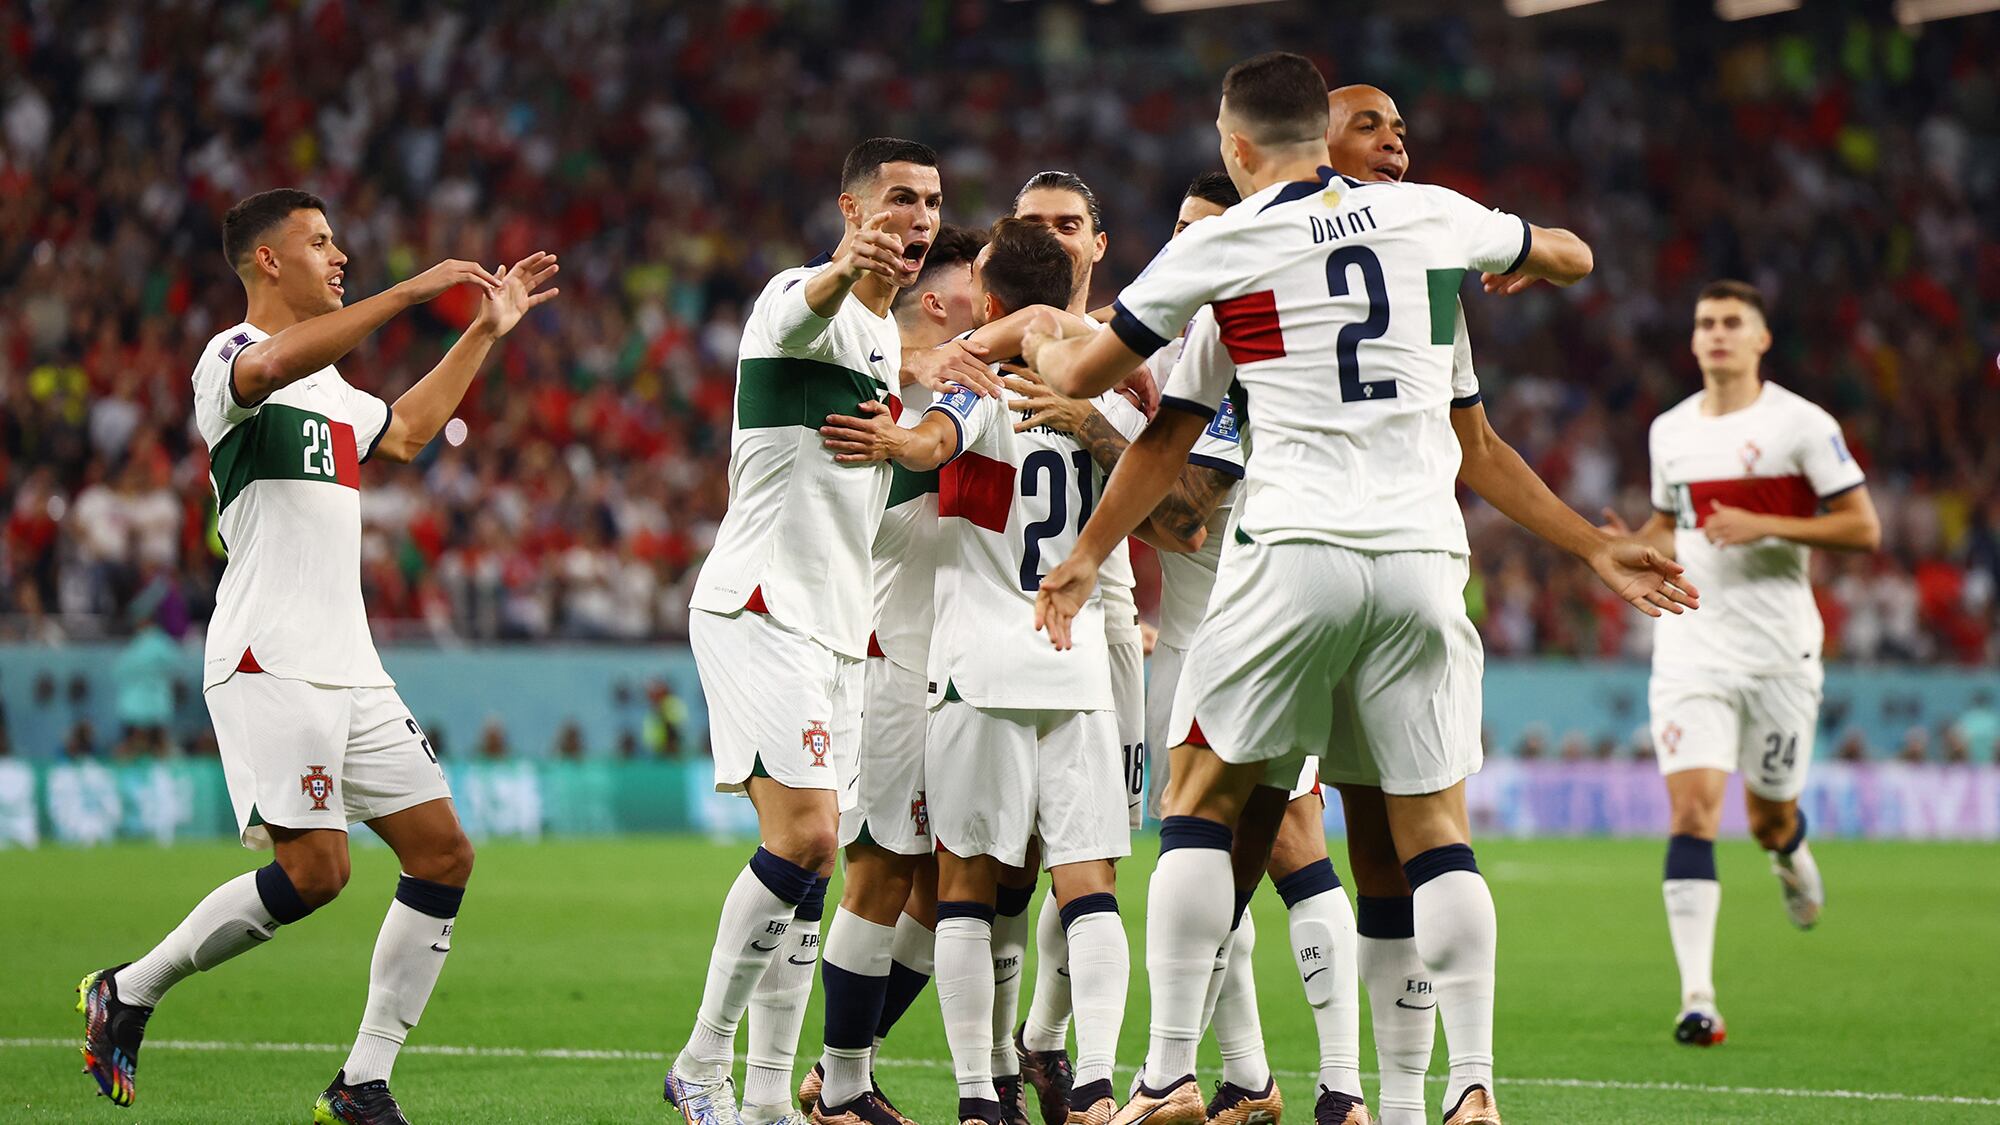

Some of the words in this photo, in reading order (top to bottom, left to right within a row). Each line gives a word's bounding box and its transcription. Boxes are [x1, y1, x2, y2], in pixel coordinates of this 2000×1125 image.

[1325, 245, 1398, 403] 2
[303, 418, 336, 477] 23
[1019, 449, 1093, 592] 21
[1123, 742, 1144, 795] 18
[1762, 732, 1799, 772] 24
